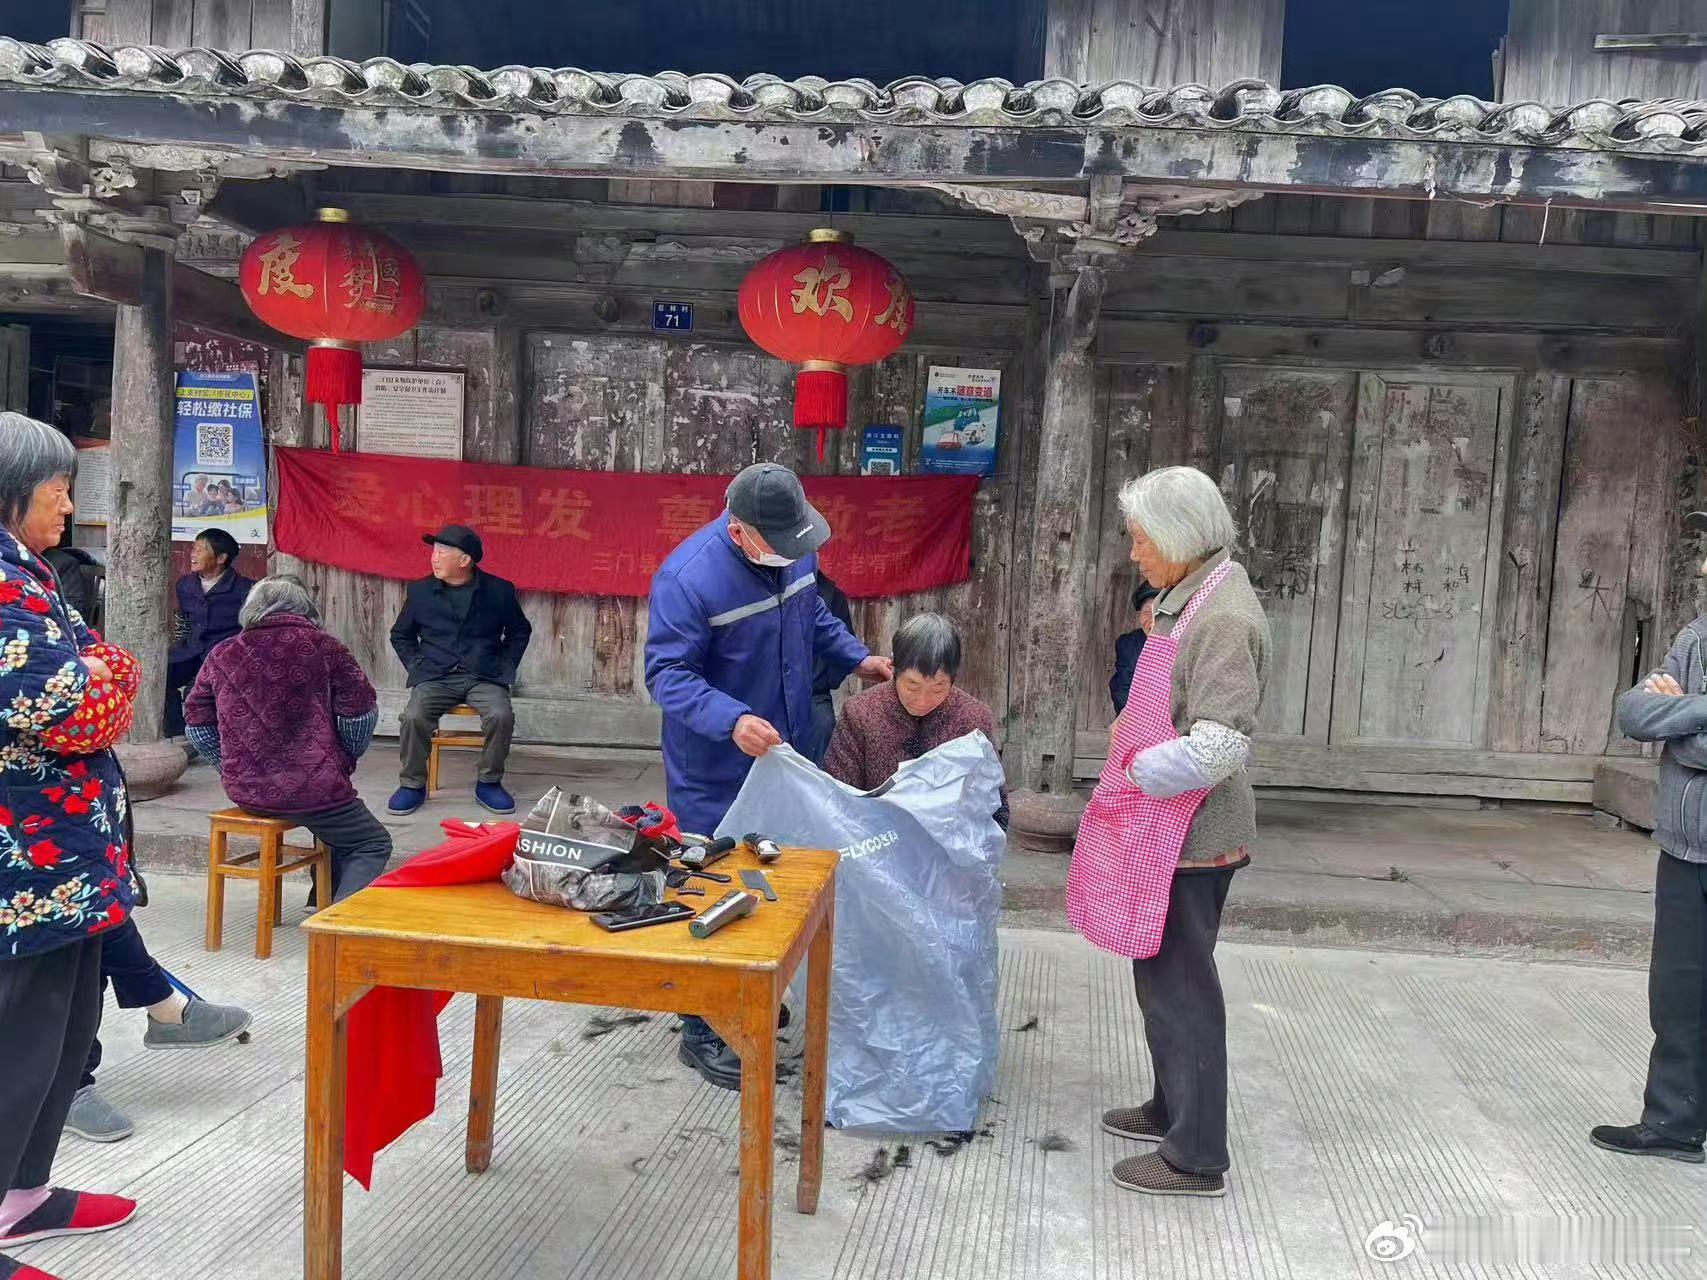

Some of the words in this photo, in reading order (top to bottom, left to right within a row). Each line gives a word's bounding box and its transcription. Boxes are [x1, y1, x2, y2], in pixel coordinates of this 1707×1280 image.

[257, 233, 315, 299] 度
[665, 314, 680, 327] 71
[176, 400, 254, 419] 轻松缴社保
